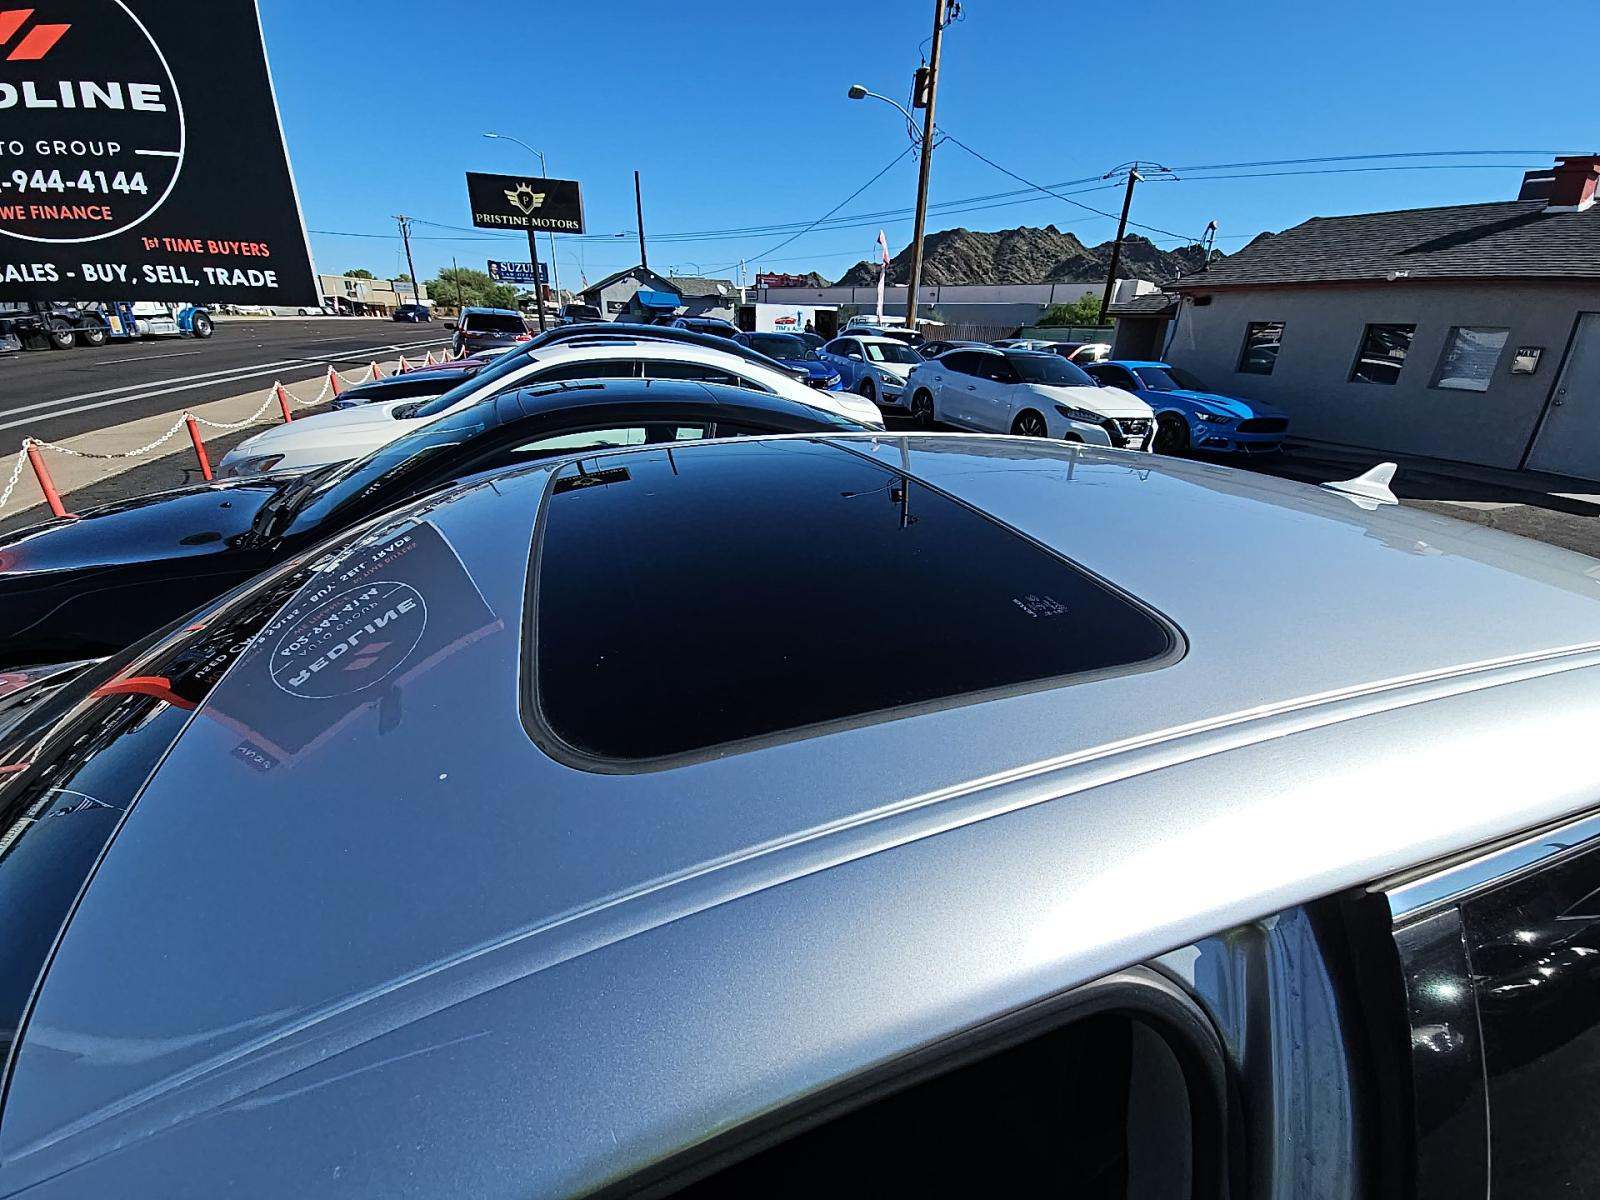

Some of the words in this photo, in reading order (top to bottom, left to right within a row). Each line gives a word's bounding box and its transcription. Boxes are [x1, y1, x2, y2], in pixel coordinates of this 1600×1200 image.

[36, 140, 121, 157] GROUP
[0, 169, 148, 195] -944-4144
[0, 205, 26, 220] WE
[30, 205, 113, 221] FINANCE
[476, 213, 529, 225] PRISTINE
[532, 217, 579, 229] MOTORS
[162, 237, 204, 253] TIME
[207, 240, 270, 258] BUYERS
[0, 263, 59, 283] ALES
[142, 264, 200, 287] SELL,
[203, 267, 279, 288] TRADE
